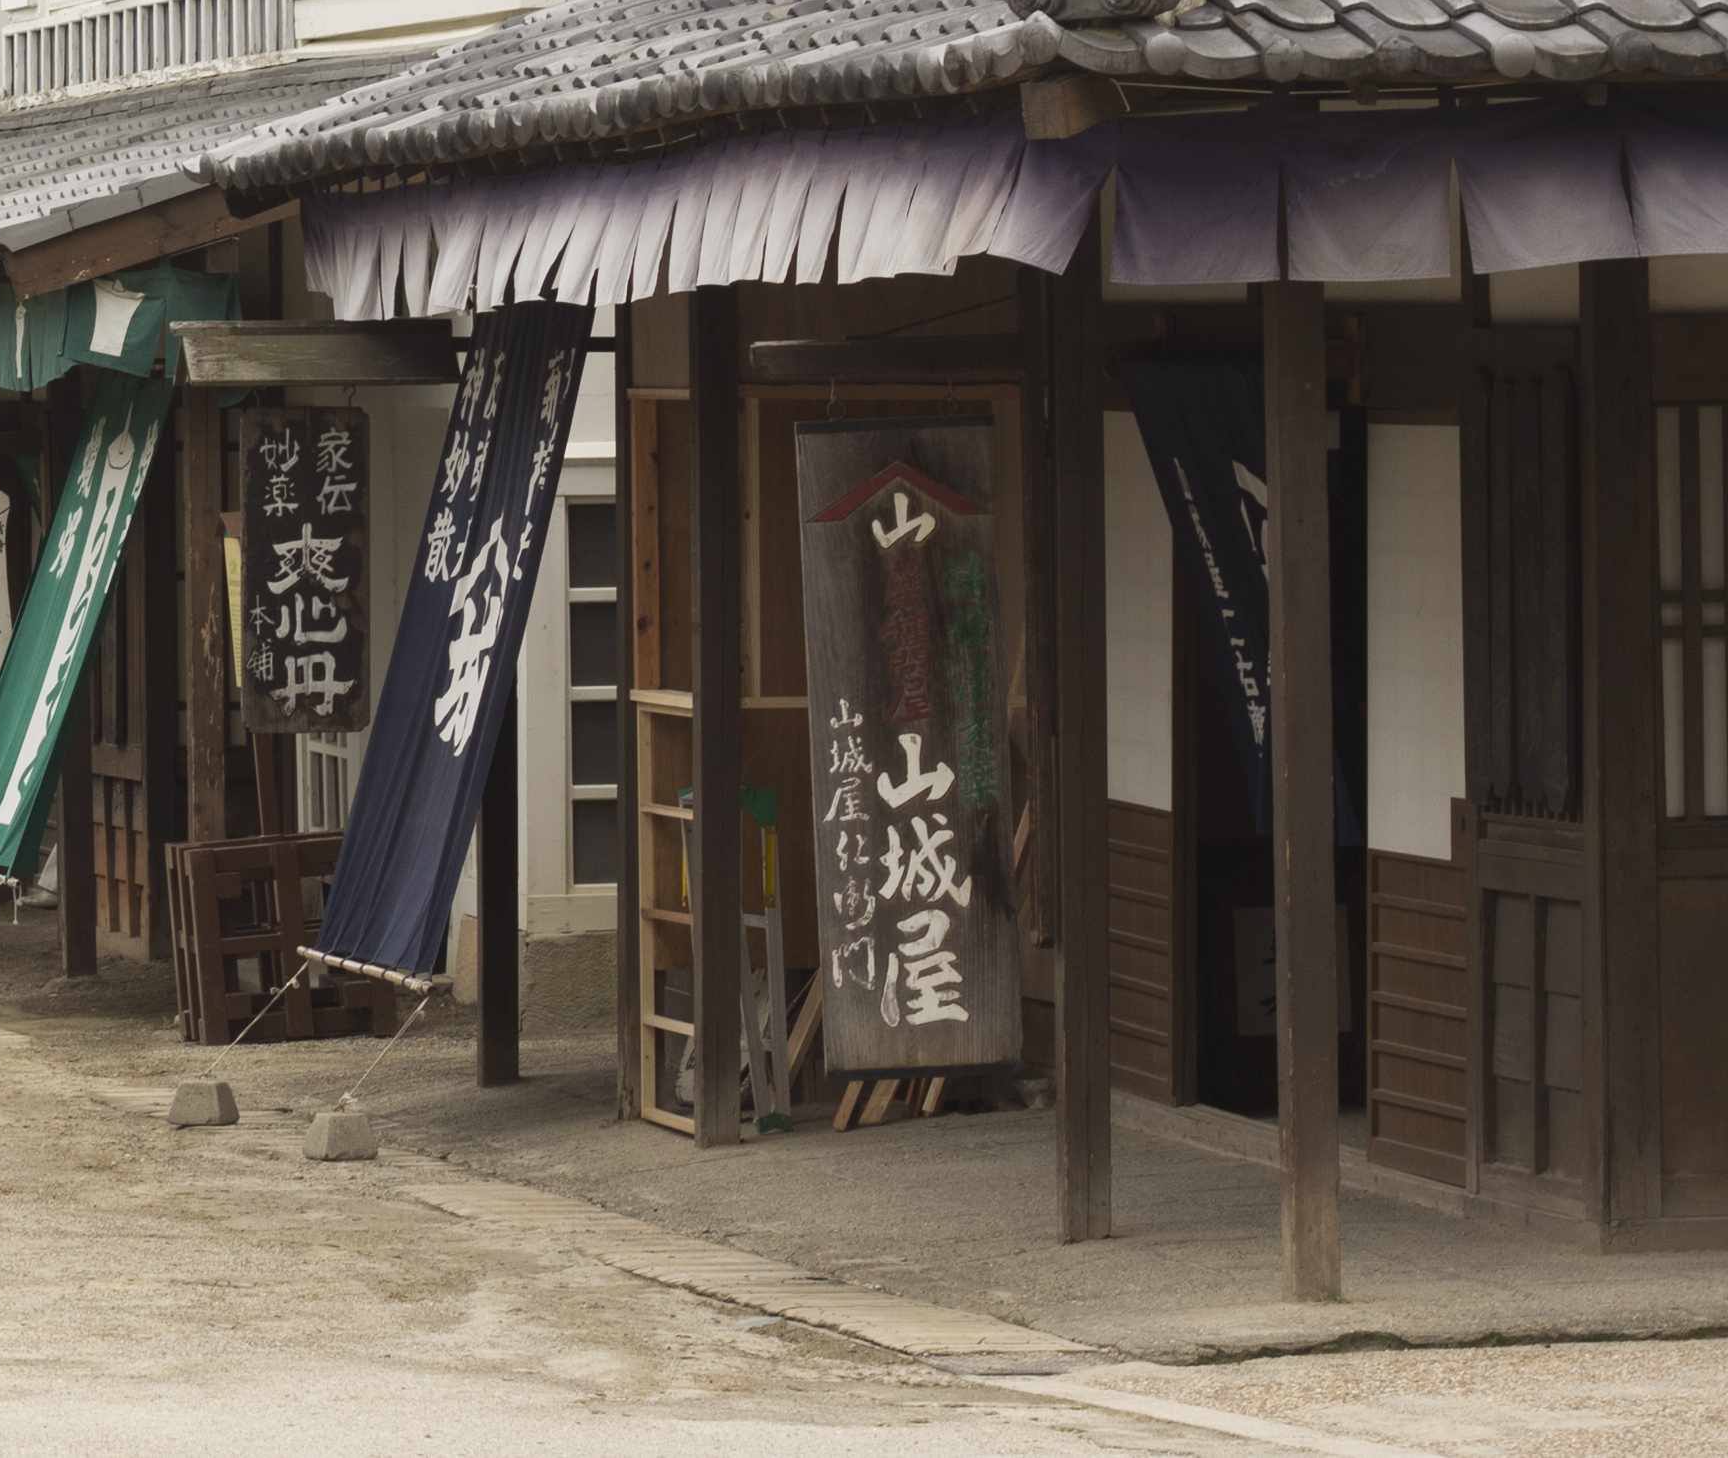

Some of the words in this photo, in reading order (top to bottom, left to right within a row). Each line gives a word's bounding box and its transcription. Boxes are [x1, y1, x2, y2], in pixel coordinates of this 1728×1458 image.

[259, 428, 300, 518] 妙薬
[316, 427, 357, 515] 家伝
[871, 492, 936, 548] 山
[266, 523, 355, 717] 爽心丹
[876, 733, 973, 1028] 山城屋
